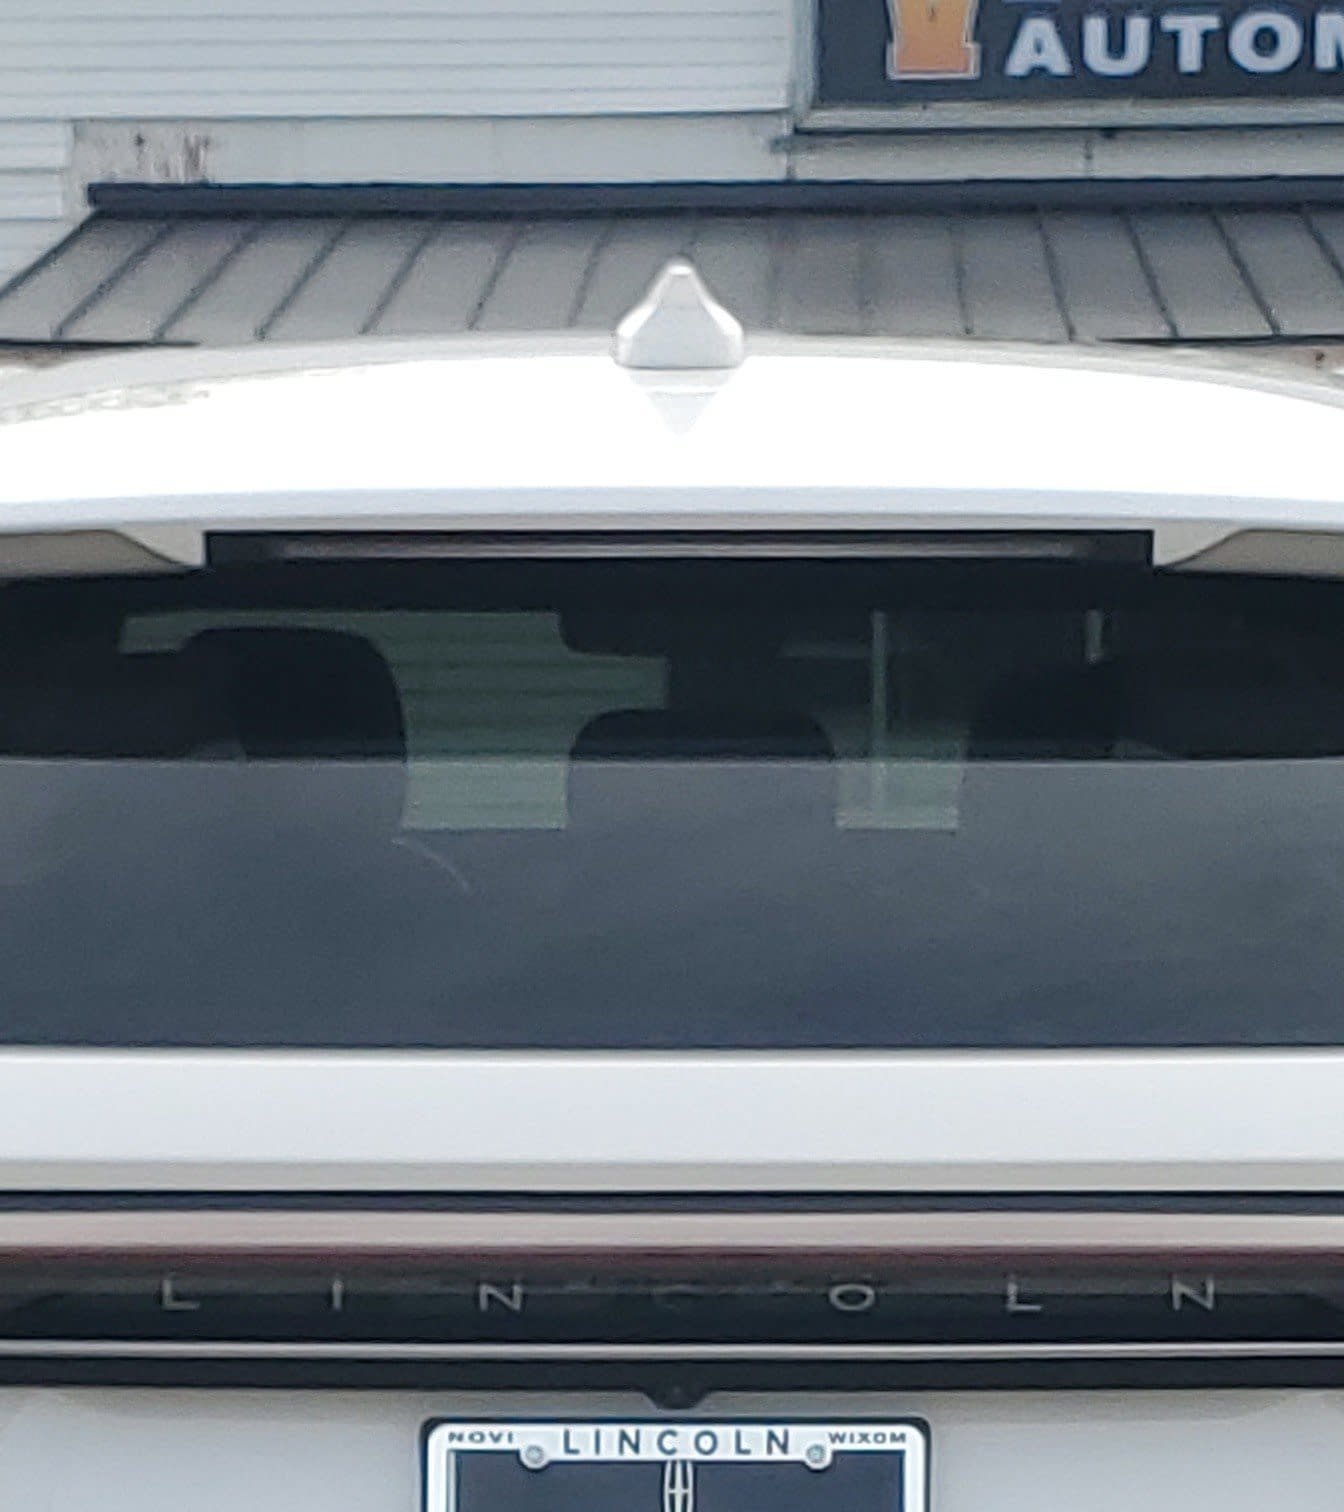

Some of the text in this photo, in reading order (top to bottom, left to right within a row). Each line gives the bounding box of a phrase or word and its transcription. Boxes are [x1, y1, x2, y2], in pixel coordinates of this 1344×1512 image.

[448, 1432, 514, 1444] NOVI
[563, 1429, 790, 1455] LINCOLN
[828, 1432, 907, 1444] WIXOM
